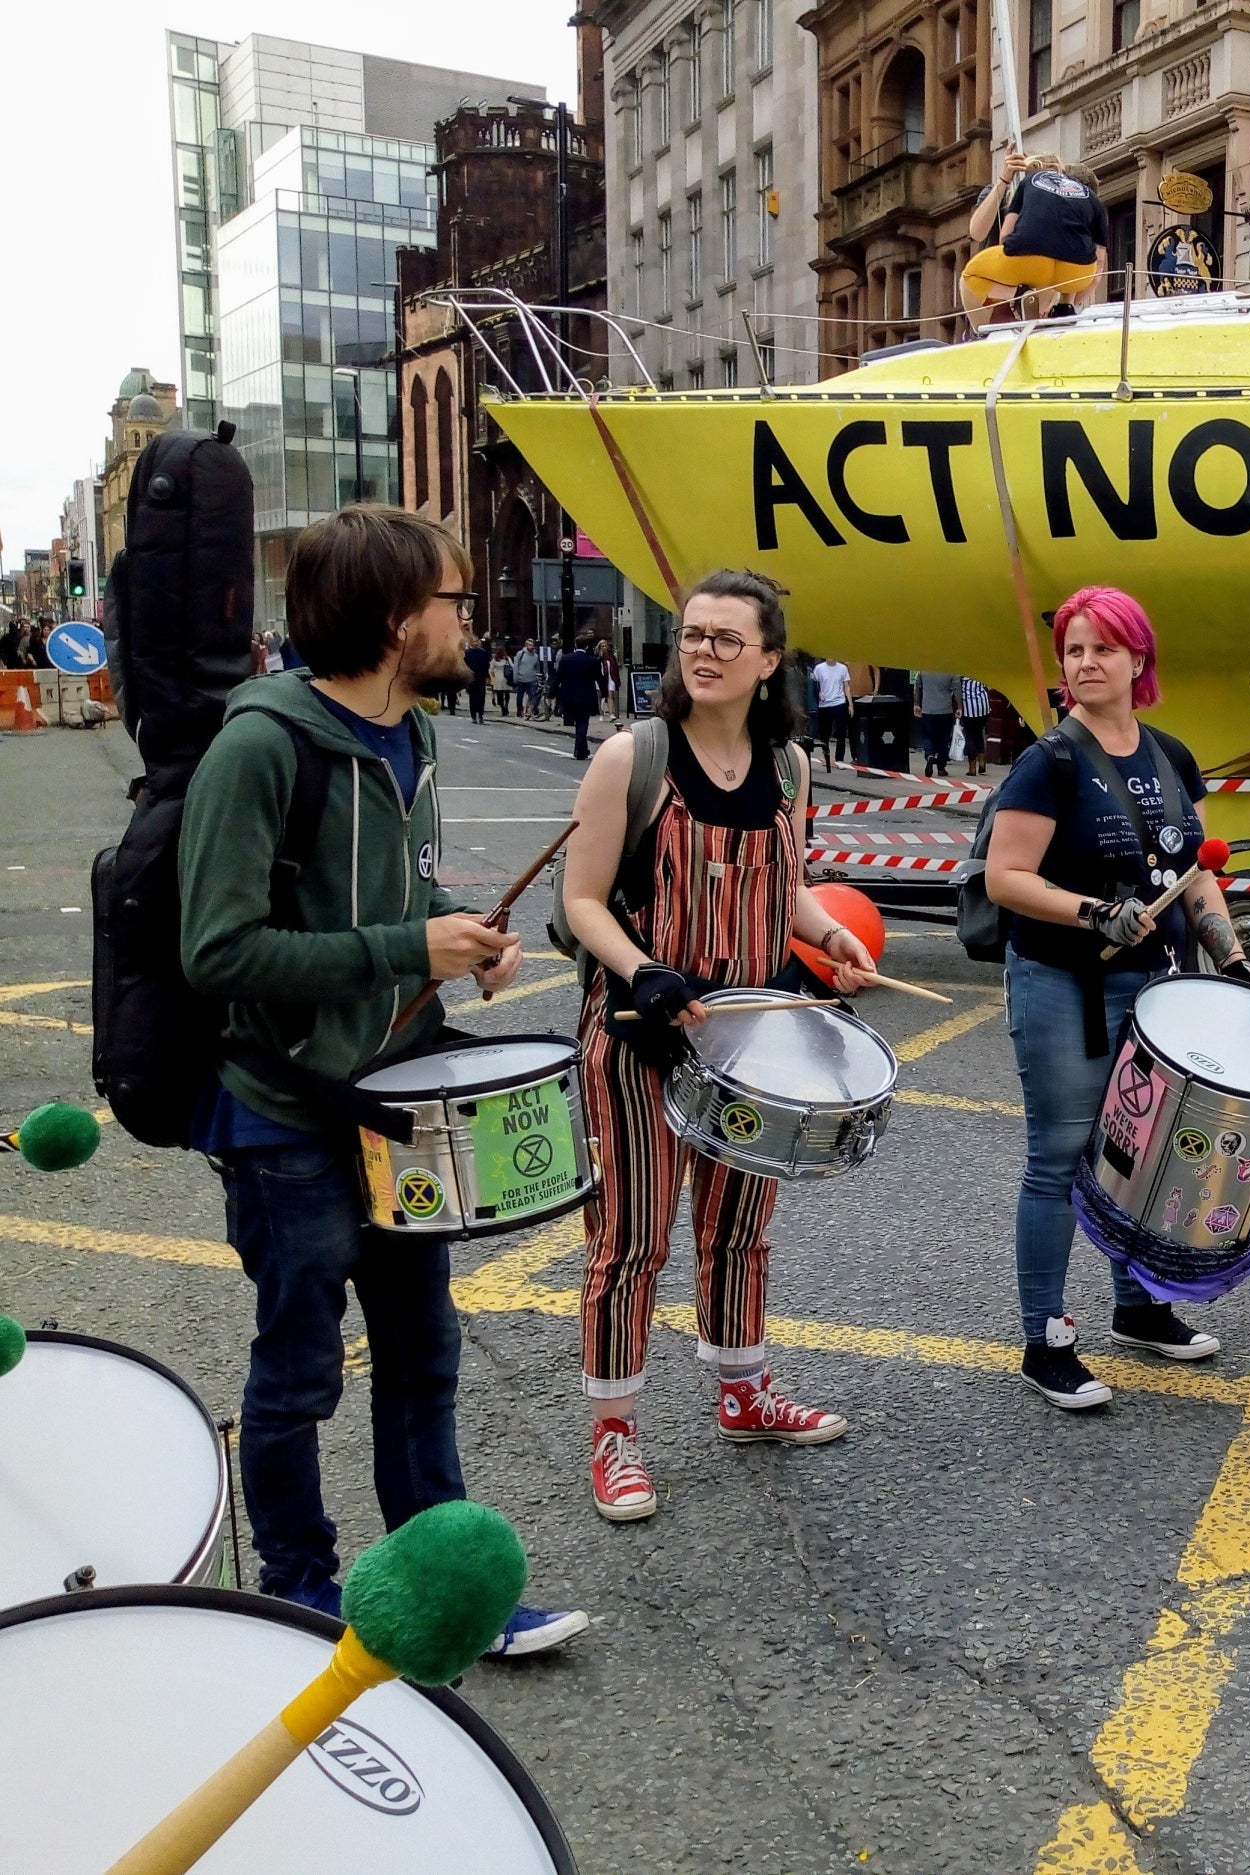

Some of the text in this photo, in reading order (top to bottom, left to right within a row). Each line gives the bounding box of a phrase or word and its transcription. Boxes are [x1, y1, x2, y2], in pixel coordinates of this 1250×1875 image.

[752, 420, 972, 550] ACT
[562, 541, 573, 549] 20
[508, 1086, 541, 1112] ACT
[503, 1104, 549, 1135] NOW
[1103, 1112, 1140, 1158] SORRY
[1113, 1104, 1138, 1139] WE'RE
[502, 1171, 568, 1199] FOR THE PEOPLE
[494, 1194, 536, 1212] ALREADY
[313, 1724, 411, 1802] IZZO
